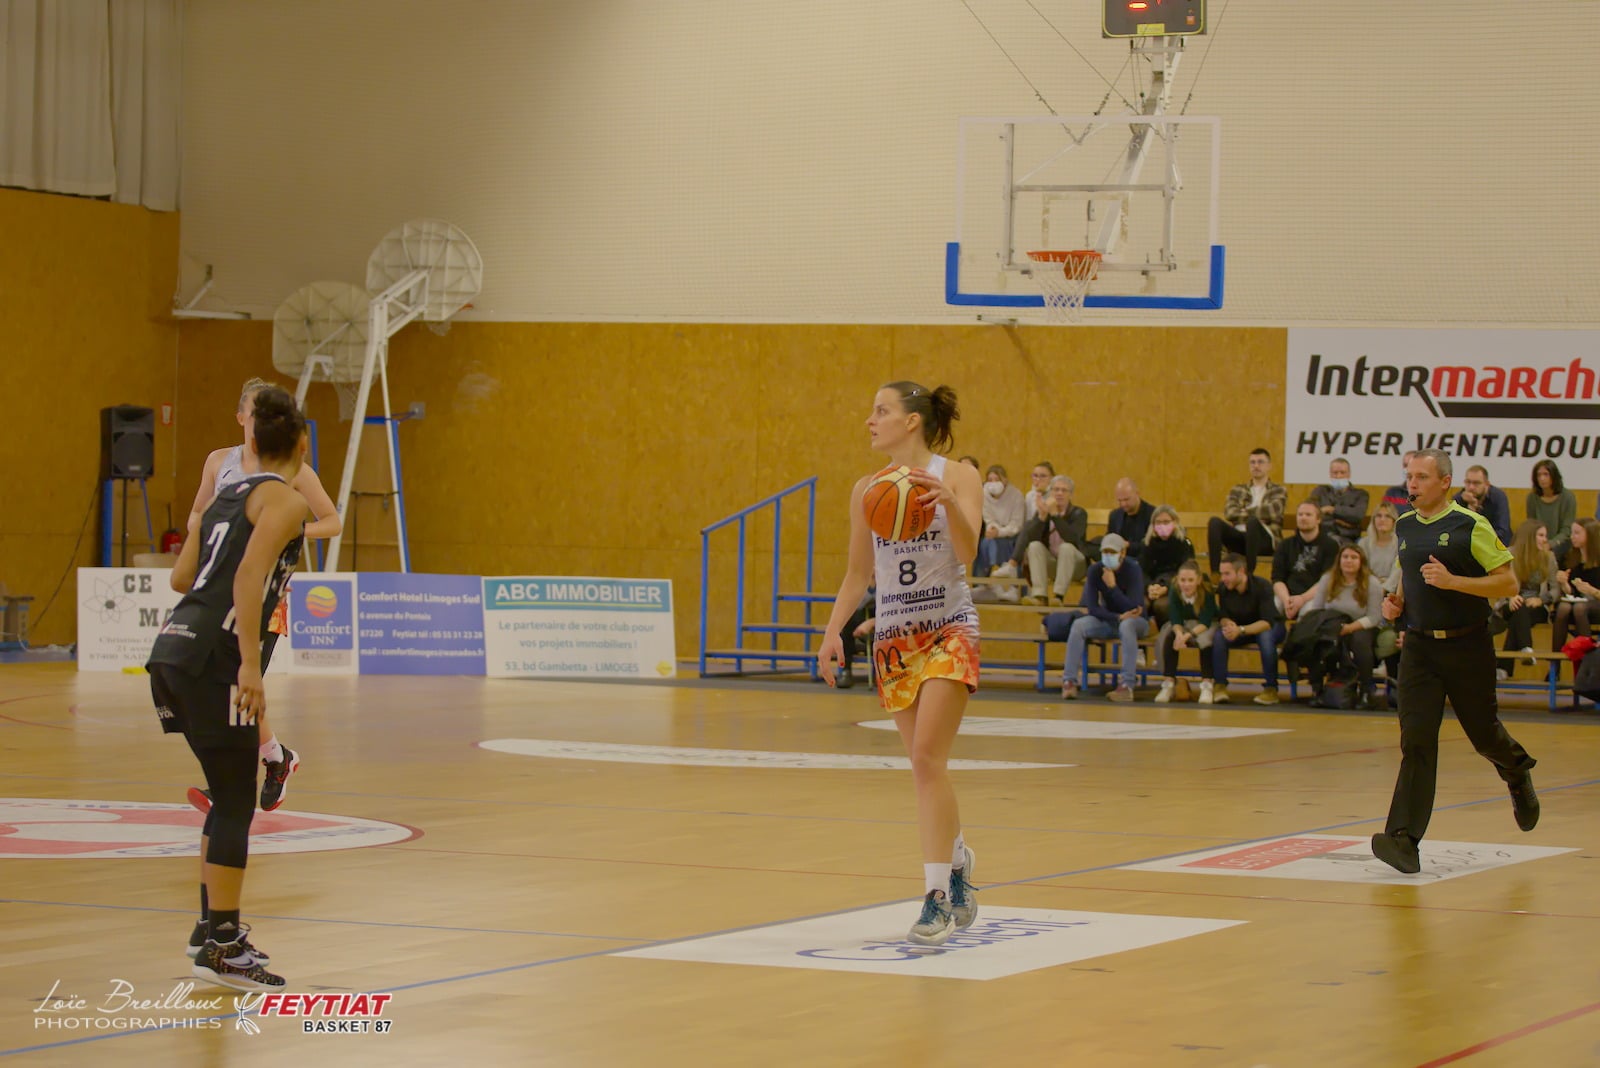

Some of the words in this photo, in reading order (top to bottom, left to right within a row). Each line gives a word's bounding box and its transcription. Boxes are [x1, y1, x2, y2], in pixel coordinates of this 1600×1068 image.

[1306, 354, 1600, 417] Intermarch
[1296, 431, 1403, 455] HYPER
[876, 530, 941, 549] FEAT
[894, 544, 929, 555] BASKET
[899, 559, 917, 586] 8
[123, 574, 152, 593] CE
[359, 591, 398, 602] Comfort
[399, 592, 422, 603] Hotel
[424, 593, 461, 606] Limoges
[462, 594, 481, 604] Sud
[494, 583, 540, 601] ABC
[545, 583, 662, 603] IMMOBILIER
[881, 585, 946, 605] Intermarché
[900, 602, 945, 614] VENTADOUR
[293, 620, 351, 635] Comfort
[498, 621, 511, 630] Le
[513, 621, 566, 633] partenaire
[567, 621, 581, 630] de
[582, 622, 607, 631] votre
[609, 621, 630, 632] club
[631, 623, 655, 633] pour
[875, 624, 902, 641] rédit
[311, 635, 335, 646] INN
[519, 640, 537, 648] vos
[538, 639, 574, 651] projets
[575, 639, 633, 650] immobiliers
[523, 660, 537, 671] bd
[538, 661, 588, 672] Gambetta
[595, 662, 640, 673] LIMOGES
